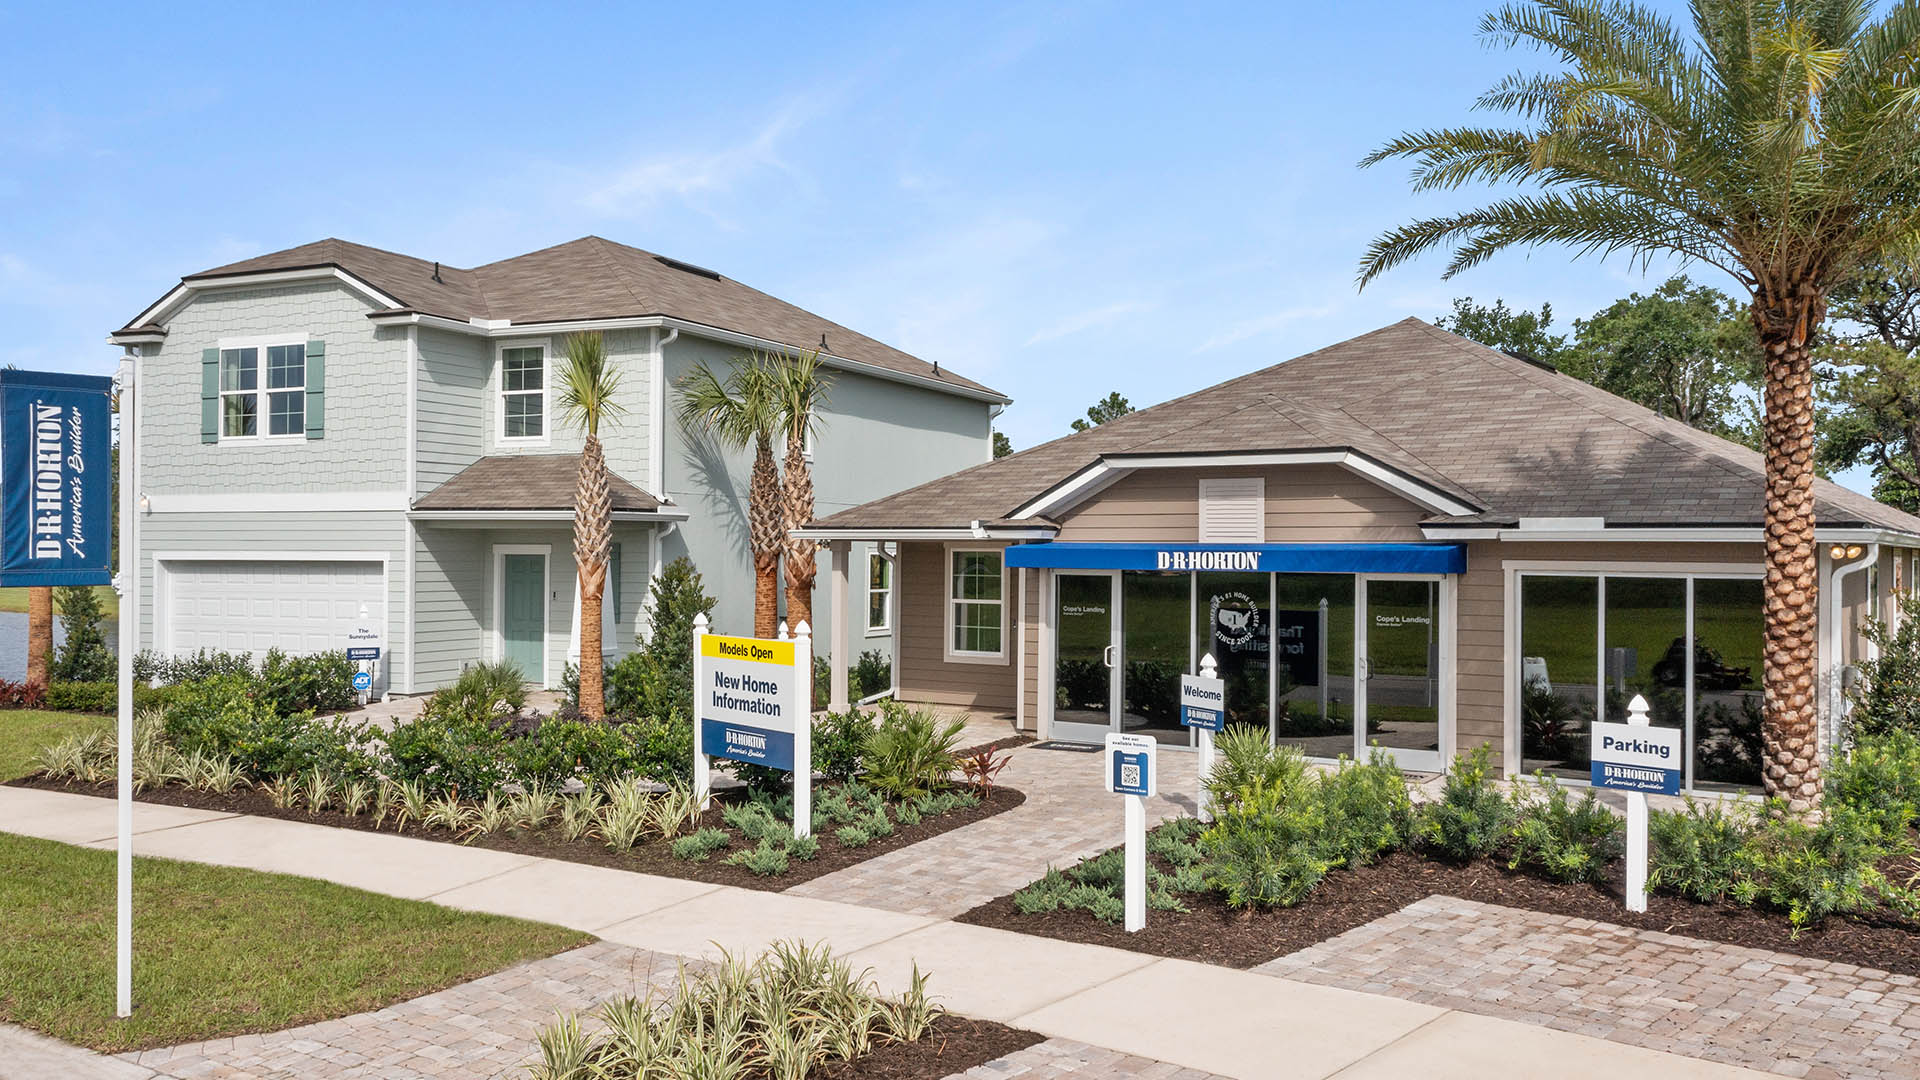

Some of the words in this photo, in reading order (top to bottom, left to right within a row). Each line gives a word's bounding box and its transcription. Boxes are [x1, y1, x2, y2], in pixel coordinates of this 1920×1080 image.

[67, 406, 85, 474] Builder
[66, 477, 86, 559] America's
[1233, 592, 1250, 602] HOME
[1248, 600, 1260, 628] BUILDER
[1376, 615, 1400, 623] Cope's
[1401, 616, 1430, 624] Landing
[1215, 630, 1236, 645] SINCE
[1236, 632, 1254, 645] 2002
[719, 642, 749, 657] Models
[750, 645, 774, 660] Open
[355, 676, 370, 684] ADT
[715, 671, 741, 690] New
[742, 674, 778, 696] Home
[1183, 684, 1222, 701] Welcome
[712, 690, 781, 717] Information
[1602, 736, 1671, 759] Parking
[1637, 781, 1664, 790] Builder
